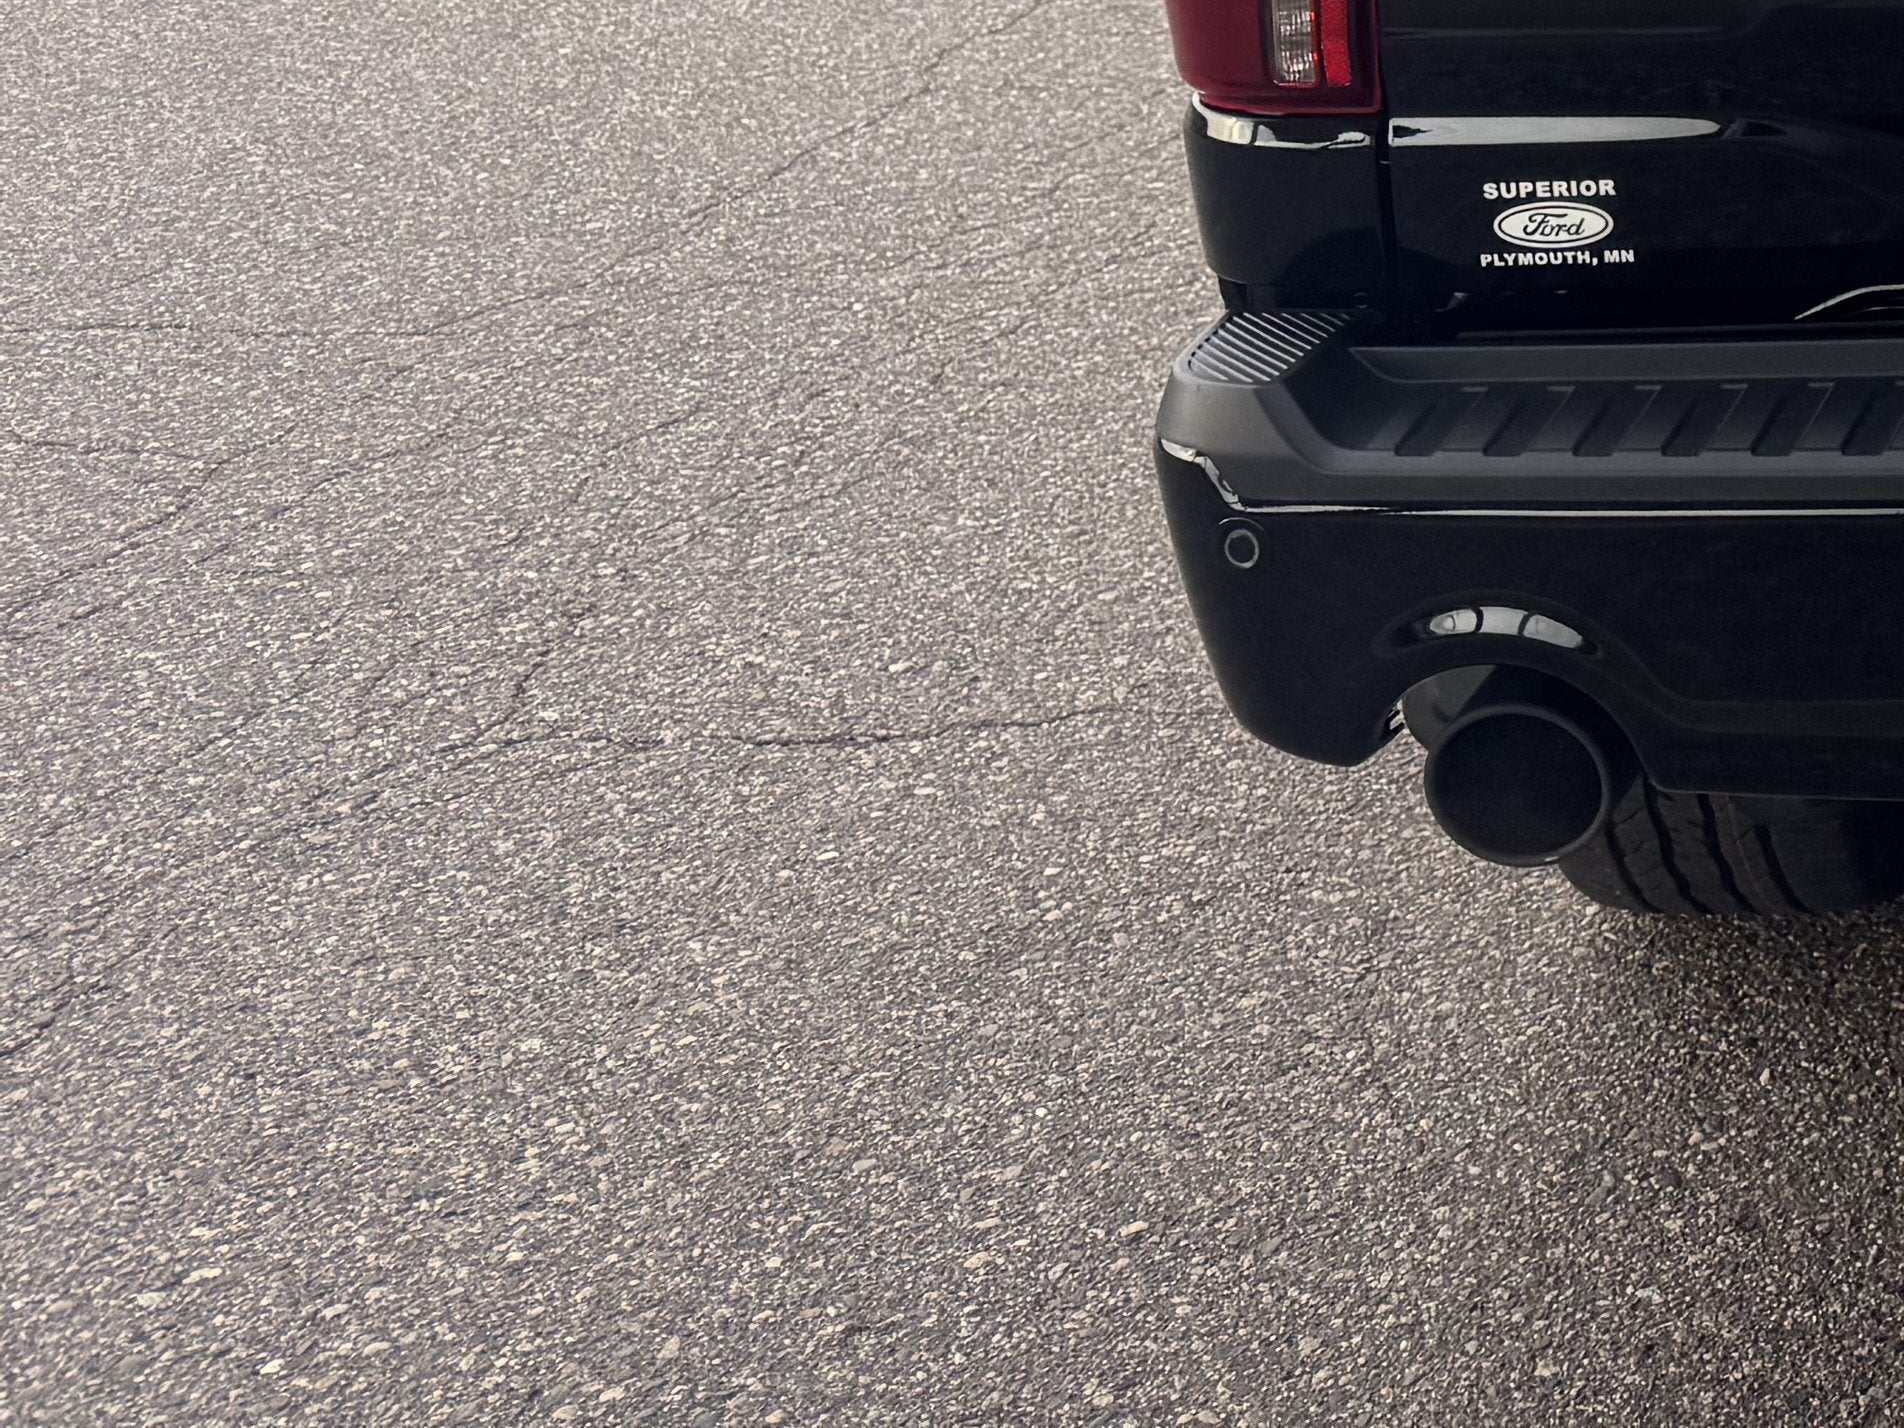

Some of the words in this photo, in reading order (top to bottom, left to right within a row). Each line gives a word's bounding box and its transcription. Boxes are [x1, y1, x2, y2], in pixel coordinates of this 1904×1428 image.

[1482, 179, 1616, 200] SUPERIOR
[1522, 212, 1586, 237] Ford
[1480, 250, 1598, 268] PLYMOUTH,
[1603, 249, 1635, 263] MN
